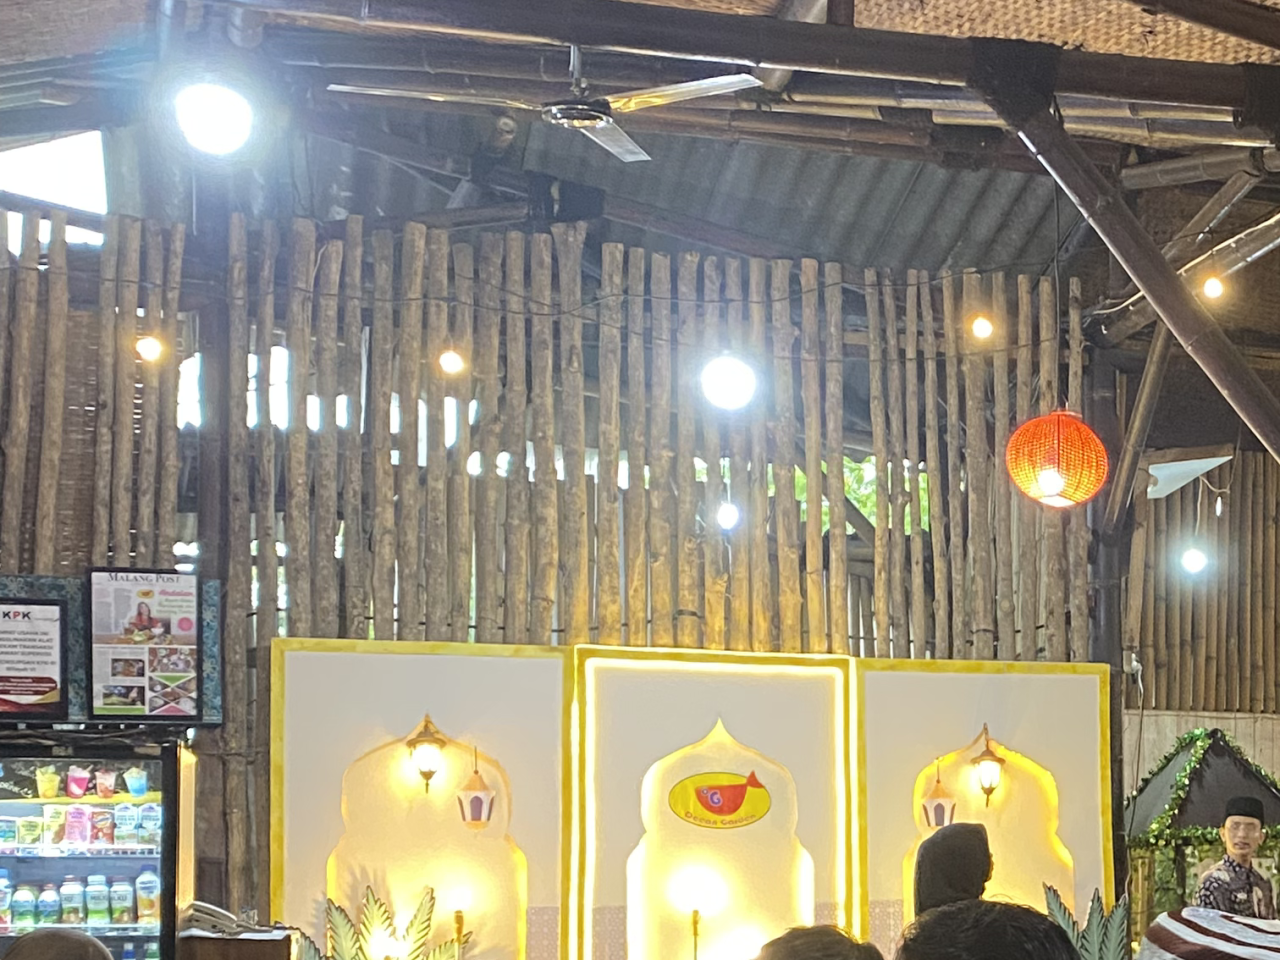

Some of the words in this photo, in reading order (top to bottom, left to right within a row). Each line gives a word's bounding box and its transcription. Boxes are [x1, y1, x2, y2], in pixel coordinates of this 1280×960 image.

[107, 572, 153, 583] MALANG
[155, 574, 180, 584] POST
[2, 611, 32, 620] KPK
[684, 810, 718, 827] Ocean
